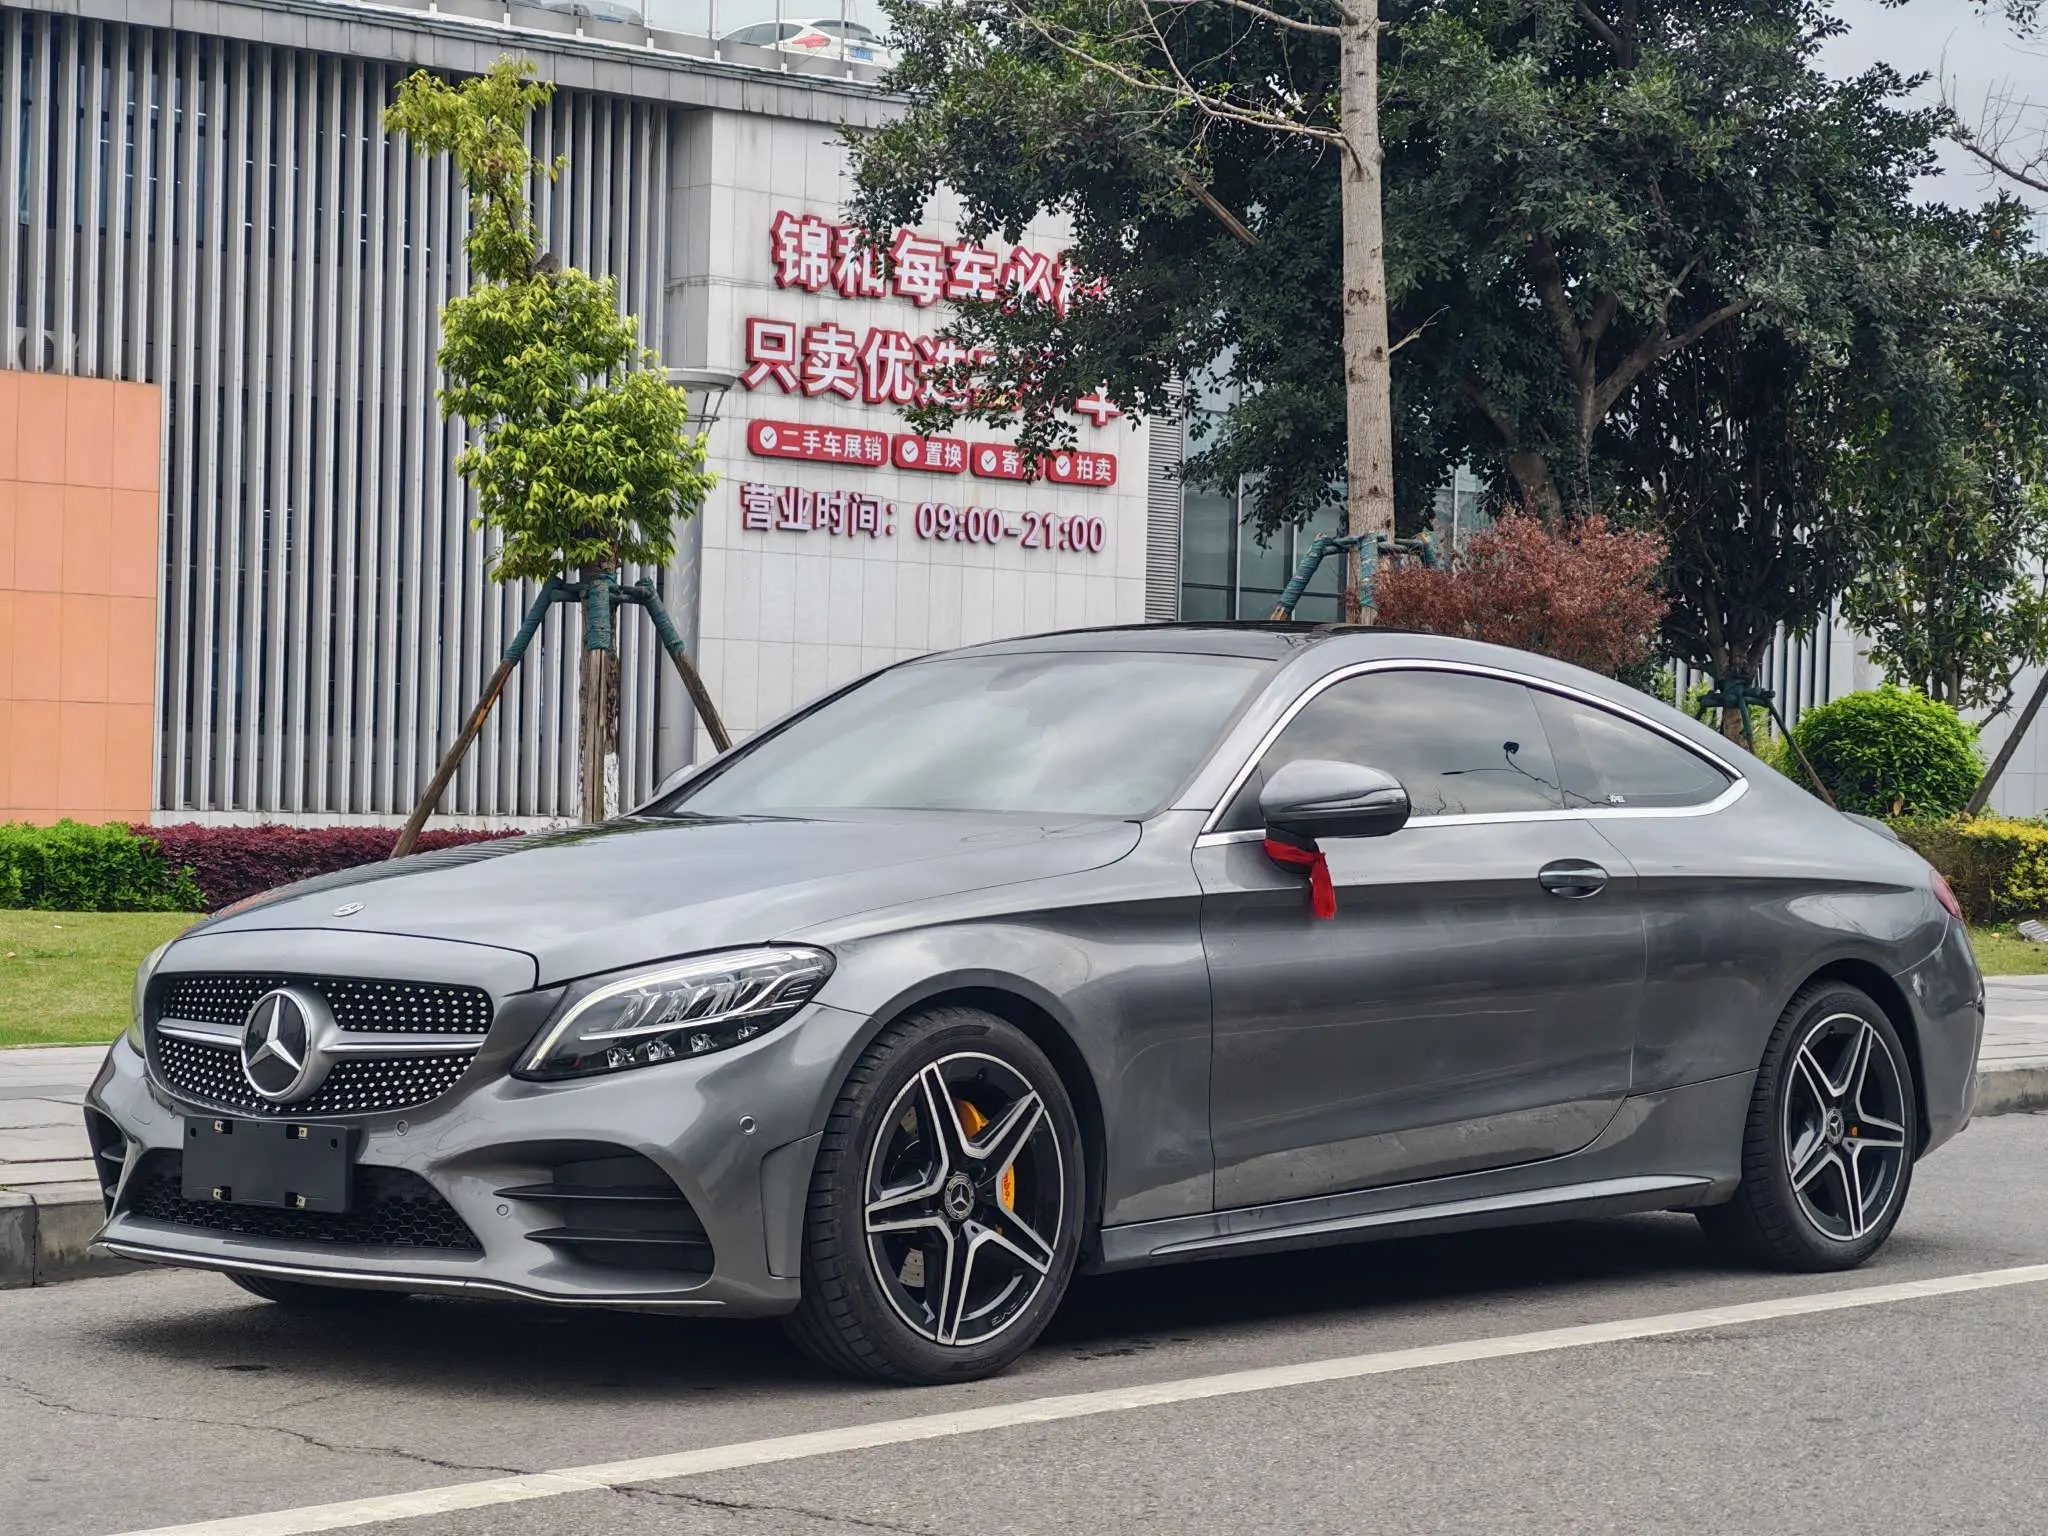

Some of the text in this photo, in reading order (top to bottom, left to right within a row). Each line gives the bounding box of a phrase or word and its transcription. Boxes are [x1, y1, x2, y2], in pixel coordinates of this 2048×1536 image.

[782, 429, 882, 462] 二手车展销
[924, 441, 962, 468] 置换
[1002, 450, 1038, 480] 寄
[1076, 456, 1112, 482] 拍卖
[915, 502, 1106, 553] 09:00-21:00
